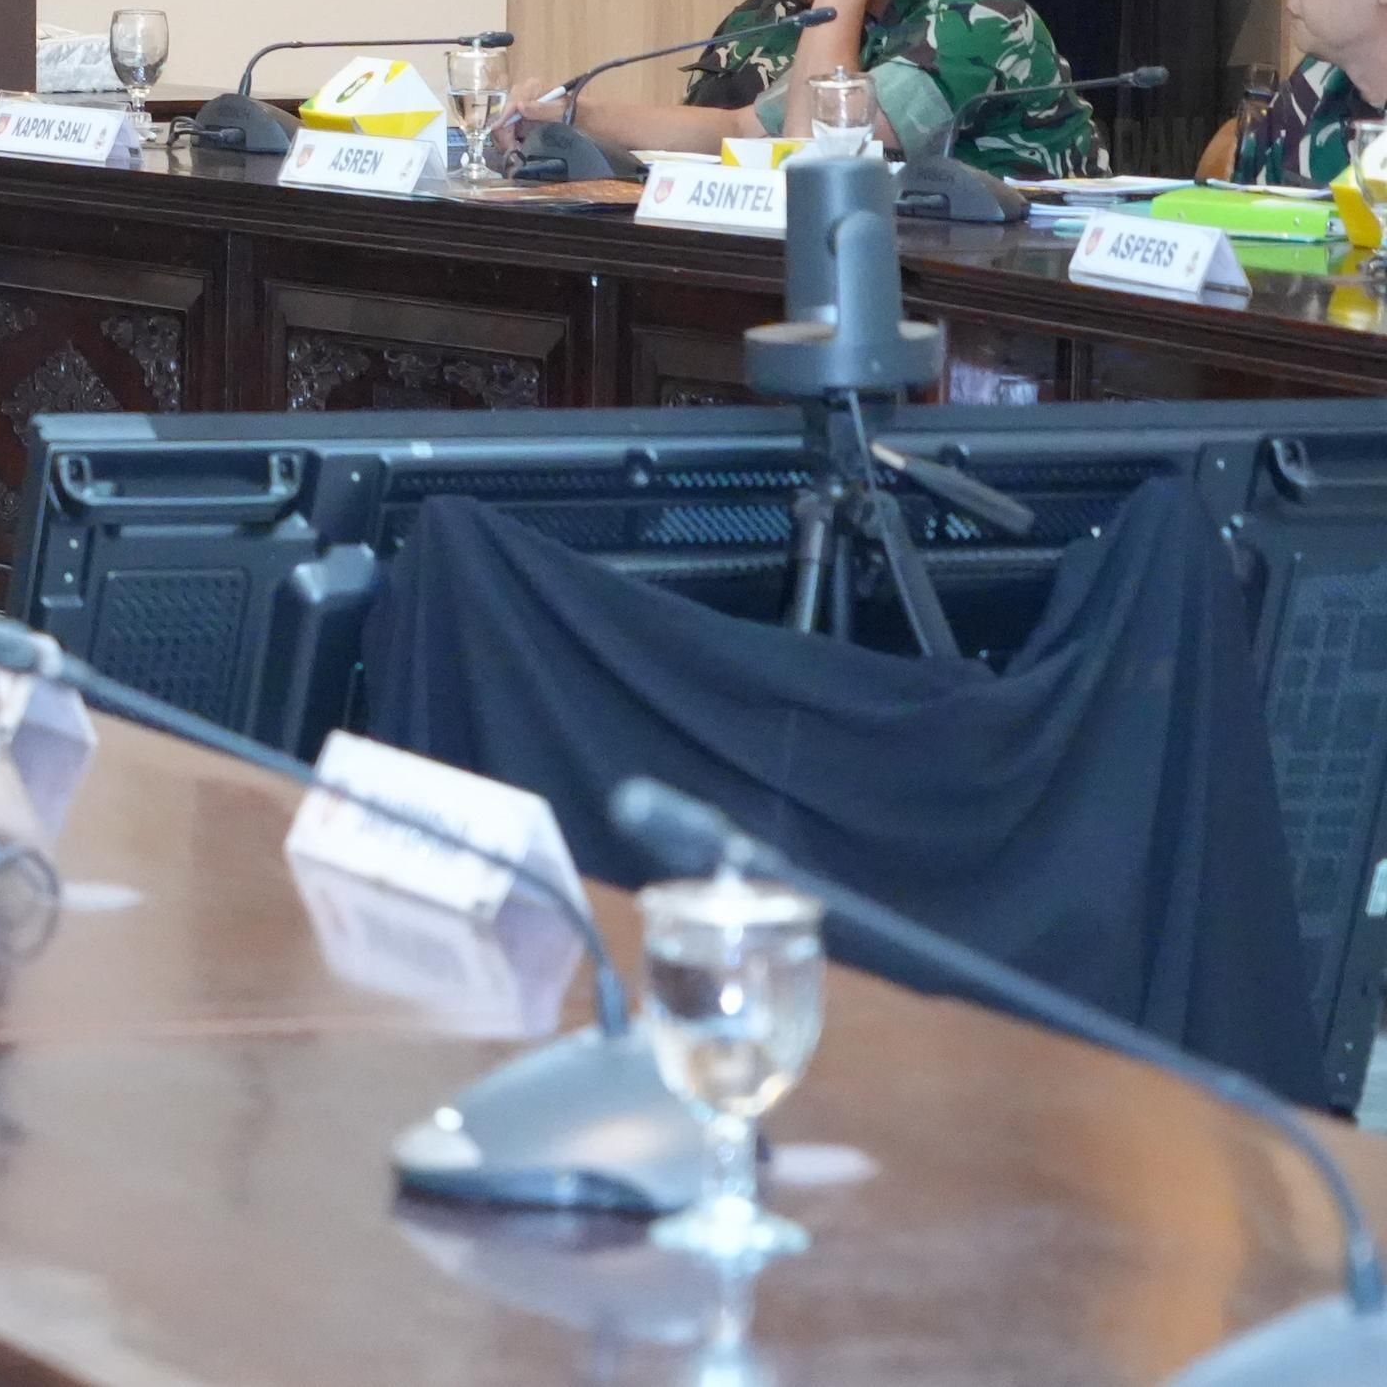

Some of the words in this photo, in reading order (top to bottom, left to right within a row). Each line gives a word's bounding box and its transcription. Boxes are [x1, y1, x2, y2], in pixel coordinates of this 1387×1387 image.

[11, 116, 56, 139] KAPOK
[53, 119, 92, 144] SAHLI
[328, 147, 384, 175] ASREN
[686, 180, 775, 213] ASINTEL
[1108, 232, 1179, 268] ASPERS
